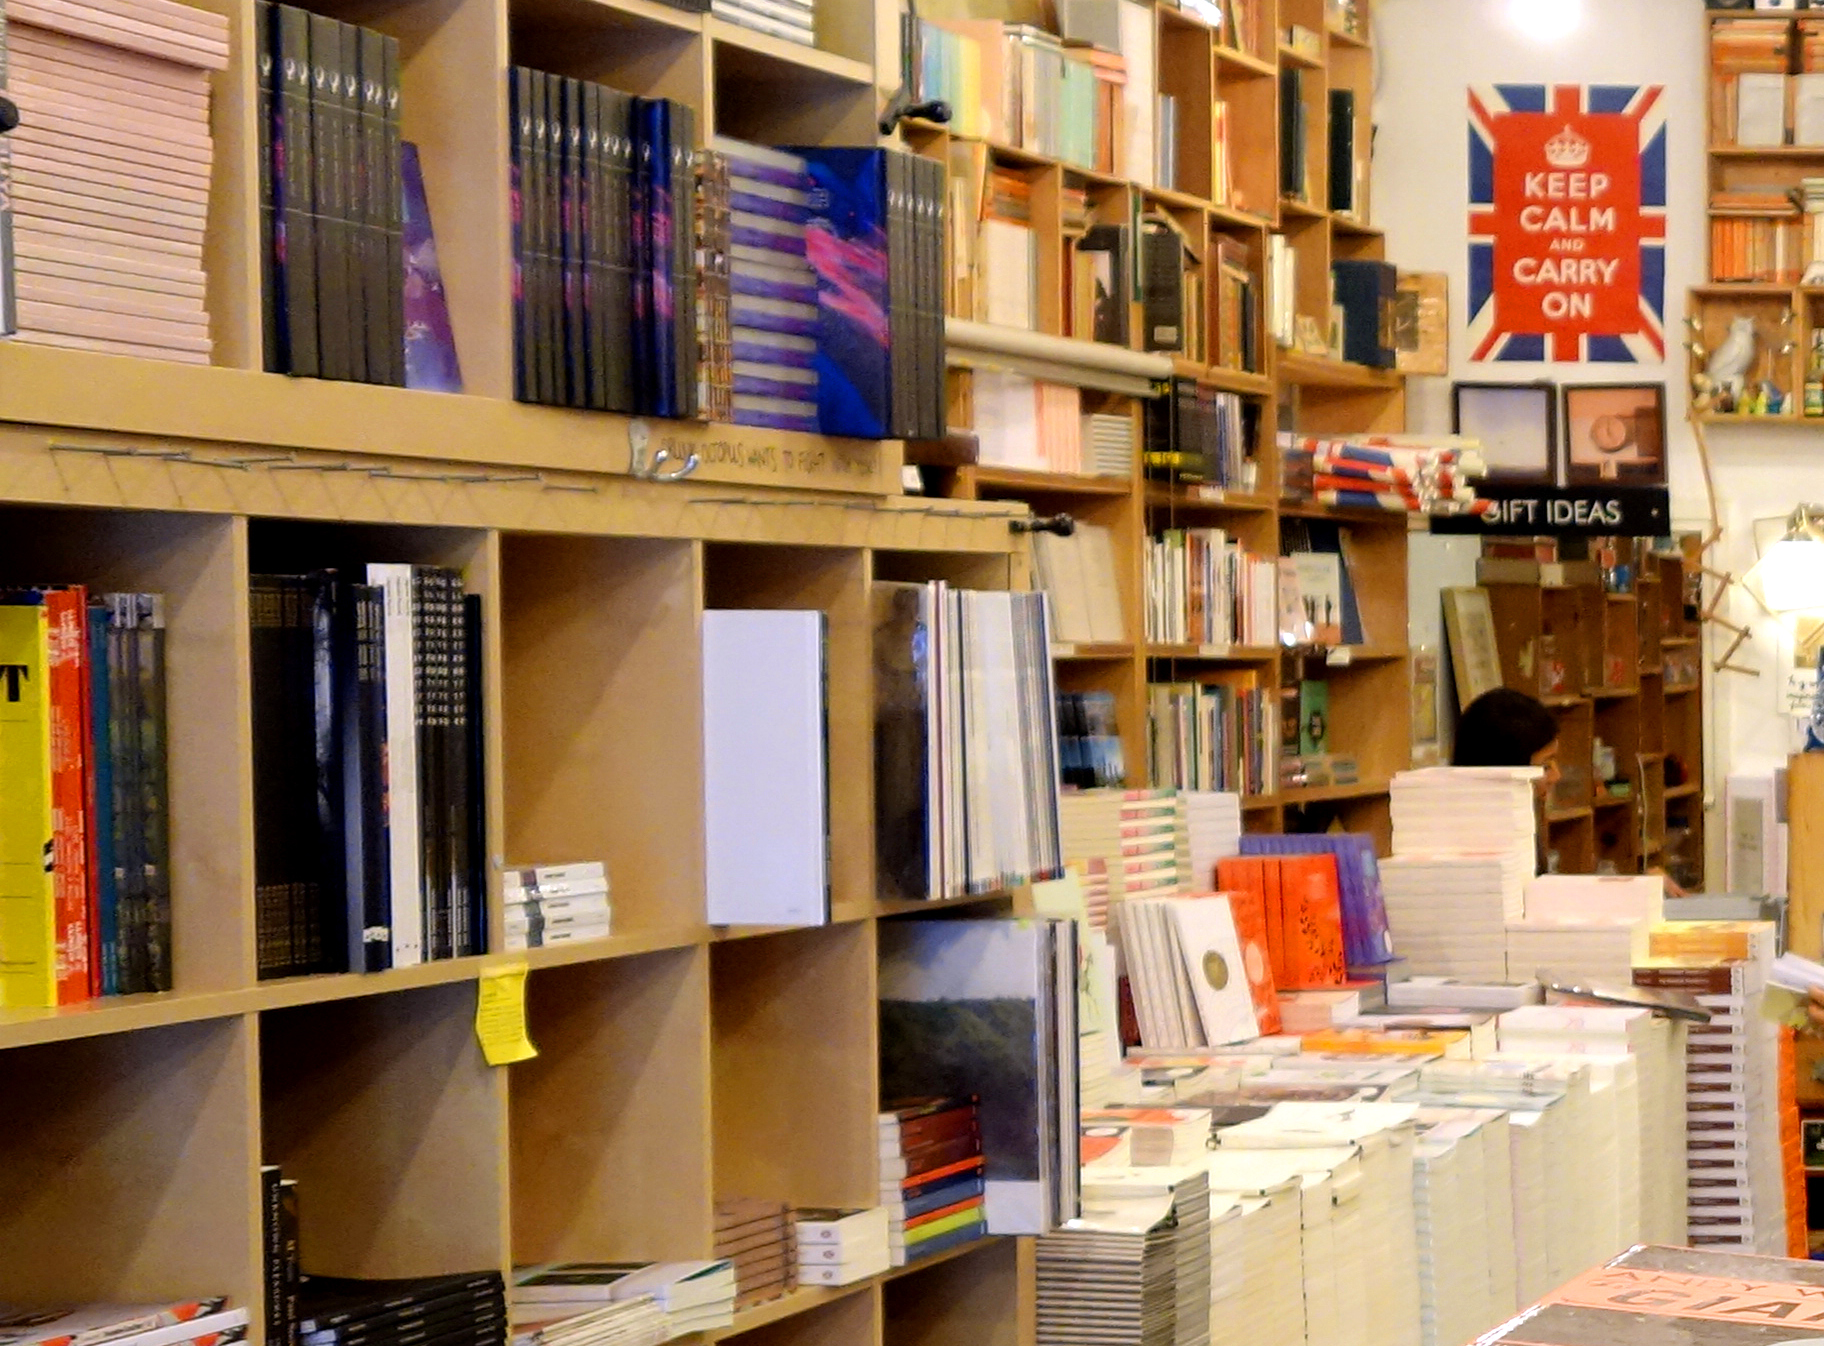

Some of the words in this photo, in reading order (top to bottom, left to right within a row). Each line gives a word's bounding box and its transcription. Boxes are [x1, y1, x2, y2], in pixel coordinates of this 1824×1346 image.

[1524, 171, 1610, 199] KEEP
[1519, 205, 1617, 233] CALM
[1549, 238, 1585, 251] AND
[1512, 257, 1620, 284] CARRY
[1541, 292, 1593, 319] ON
[1481, 499, 1538, 524] GIFT
[1546, 499, 1622, 524] IDEAS
[1604, 1269, 1767, 1292] ANDY
